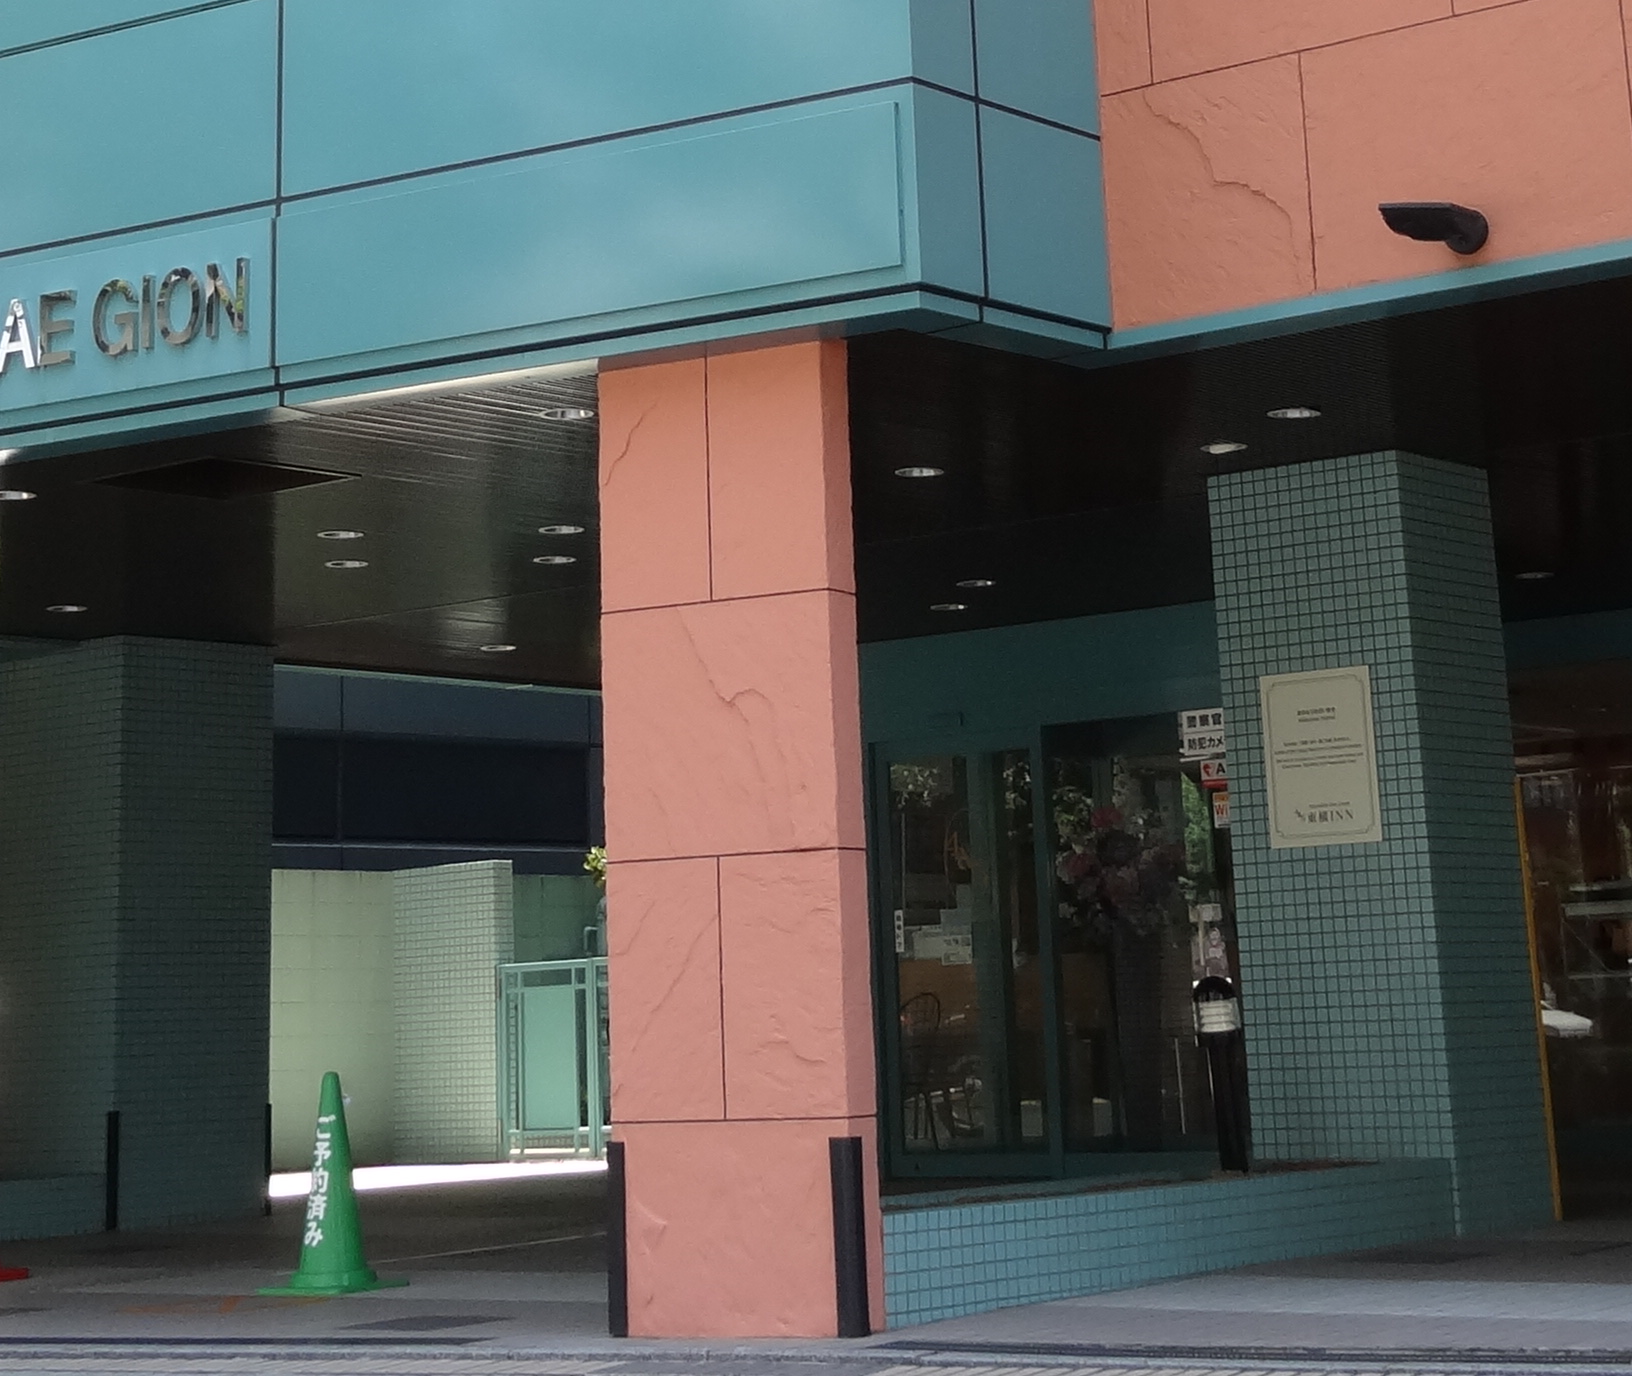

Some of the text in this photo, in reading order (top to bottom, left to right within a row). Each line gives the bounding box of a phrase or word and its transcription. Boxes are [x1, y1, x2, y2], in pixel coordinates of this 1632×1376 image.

[92, 256, 252, 358] GION
[304, 1114, 337, 1247] ご予約済み
